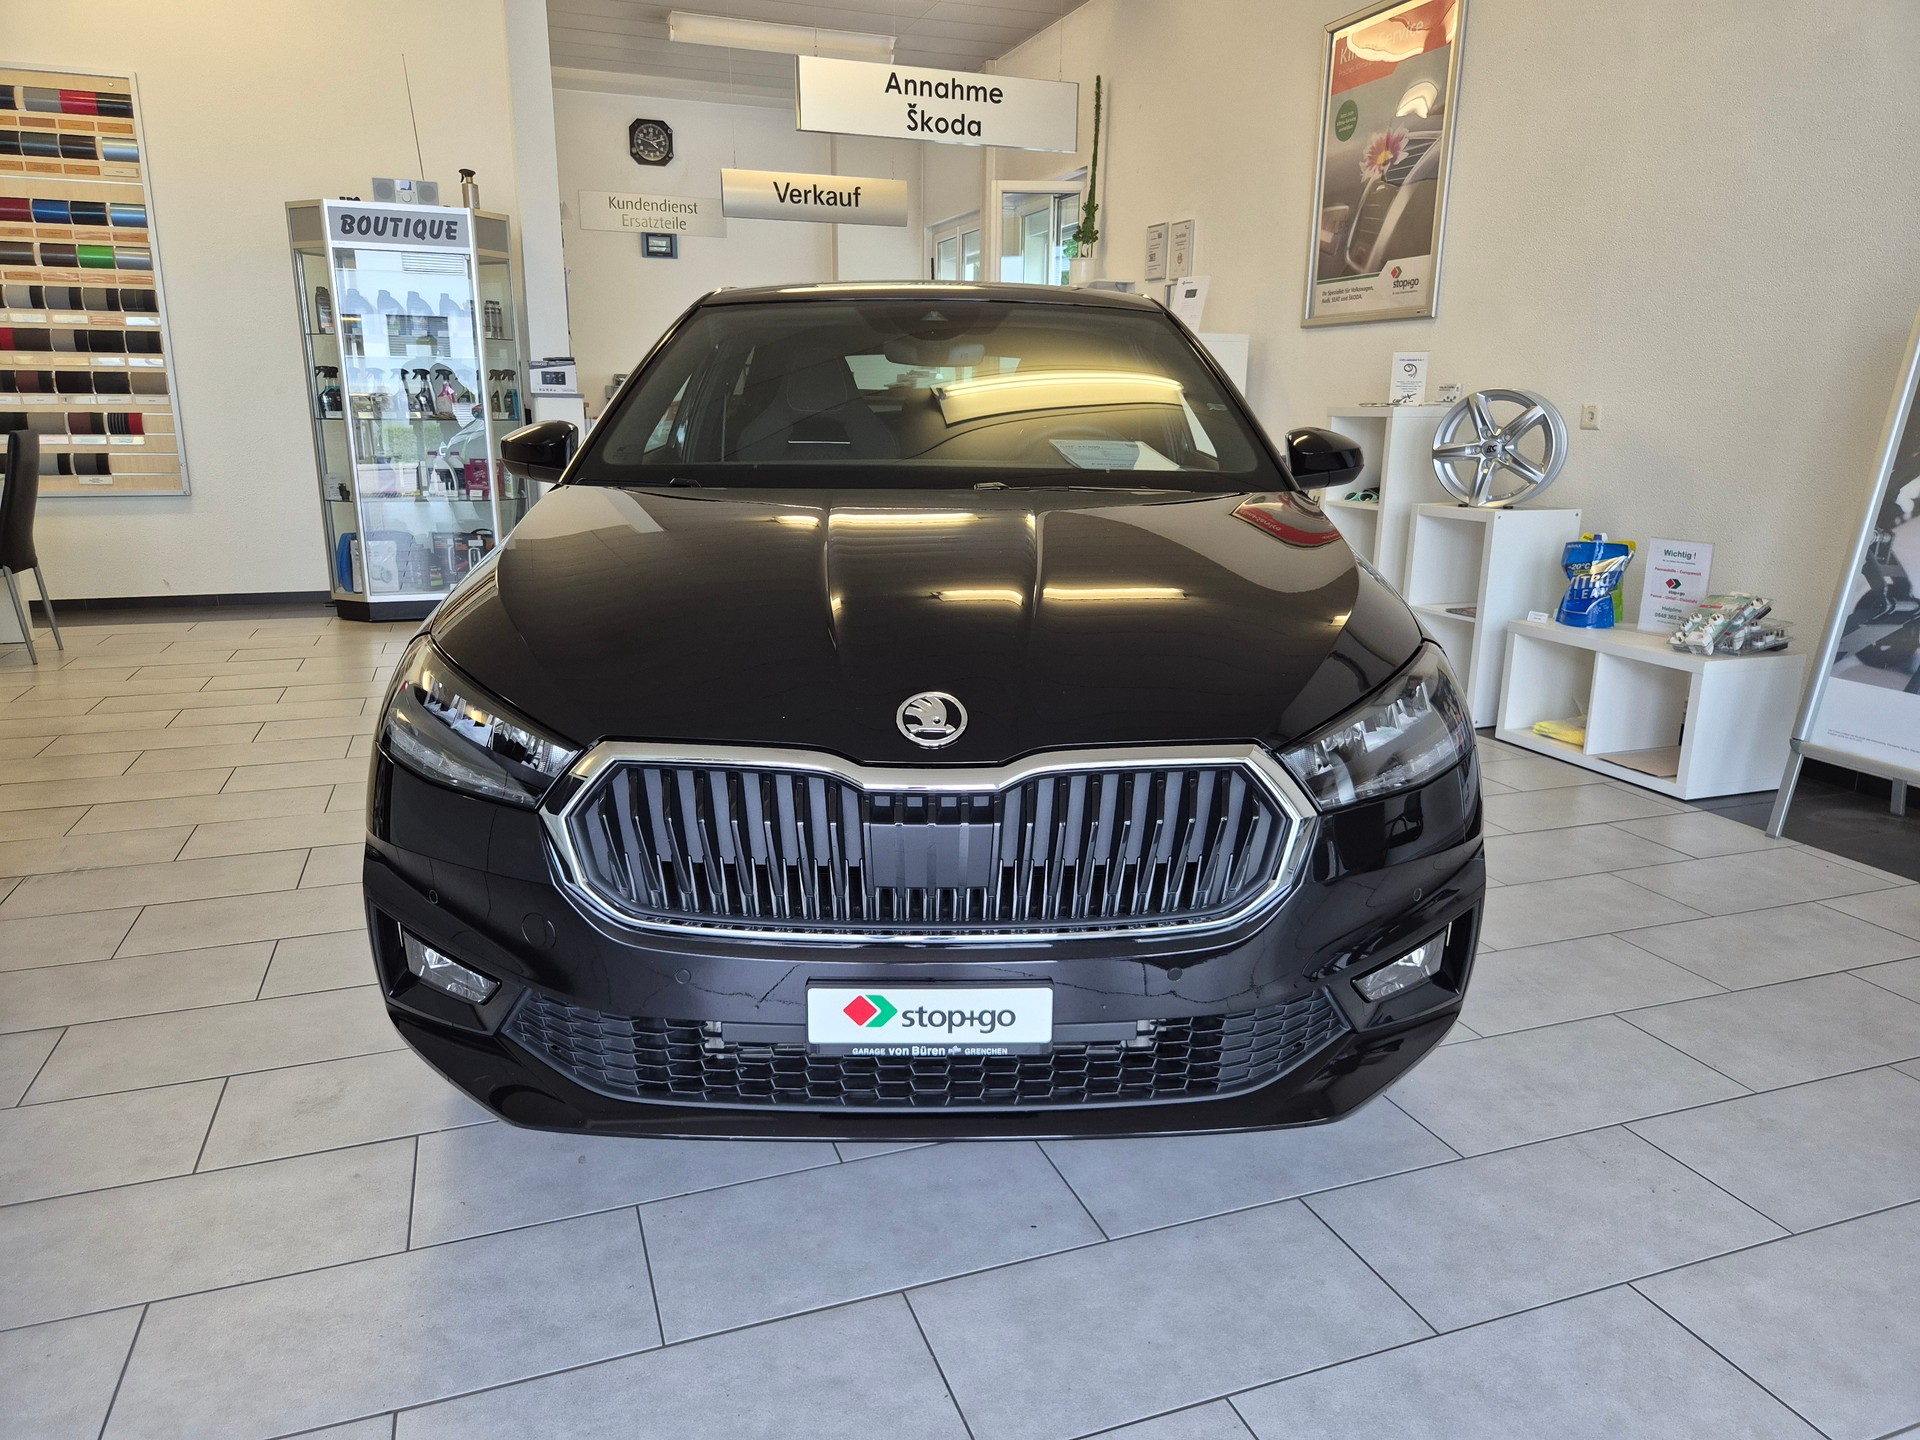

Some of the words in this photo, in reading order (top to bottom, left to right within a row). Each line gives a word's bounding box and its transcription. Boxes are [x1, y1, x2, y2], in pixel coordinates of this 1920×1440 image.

[884, 71, 1004, 104] Annahme
[906, 102, 982, 137] Škoda
[773, 181, 862, 207] Verkauf
[608, 195, 699, 215] Kundendienst
[340, 214, 458, 241] BOUTIQUE
[622, 213, 687, 230] Ersatzteile
[1393, 278, 1420, 290] stop+go
[1663, 549, 1692, 560] Wichtig
[1661, 605, 1683, 613] Helpline
[901, 1005, 1017, 1034] stop+go
[852, 1047, 886, 1056] GARAGE
[888, 1047, 909, 1056] von
[911, 1045, 946, 1056] Büren
[964, 1047, 1008, 1056] GRENCHEN
